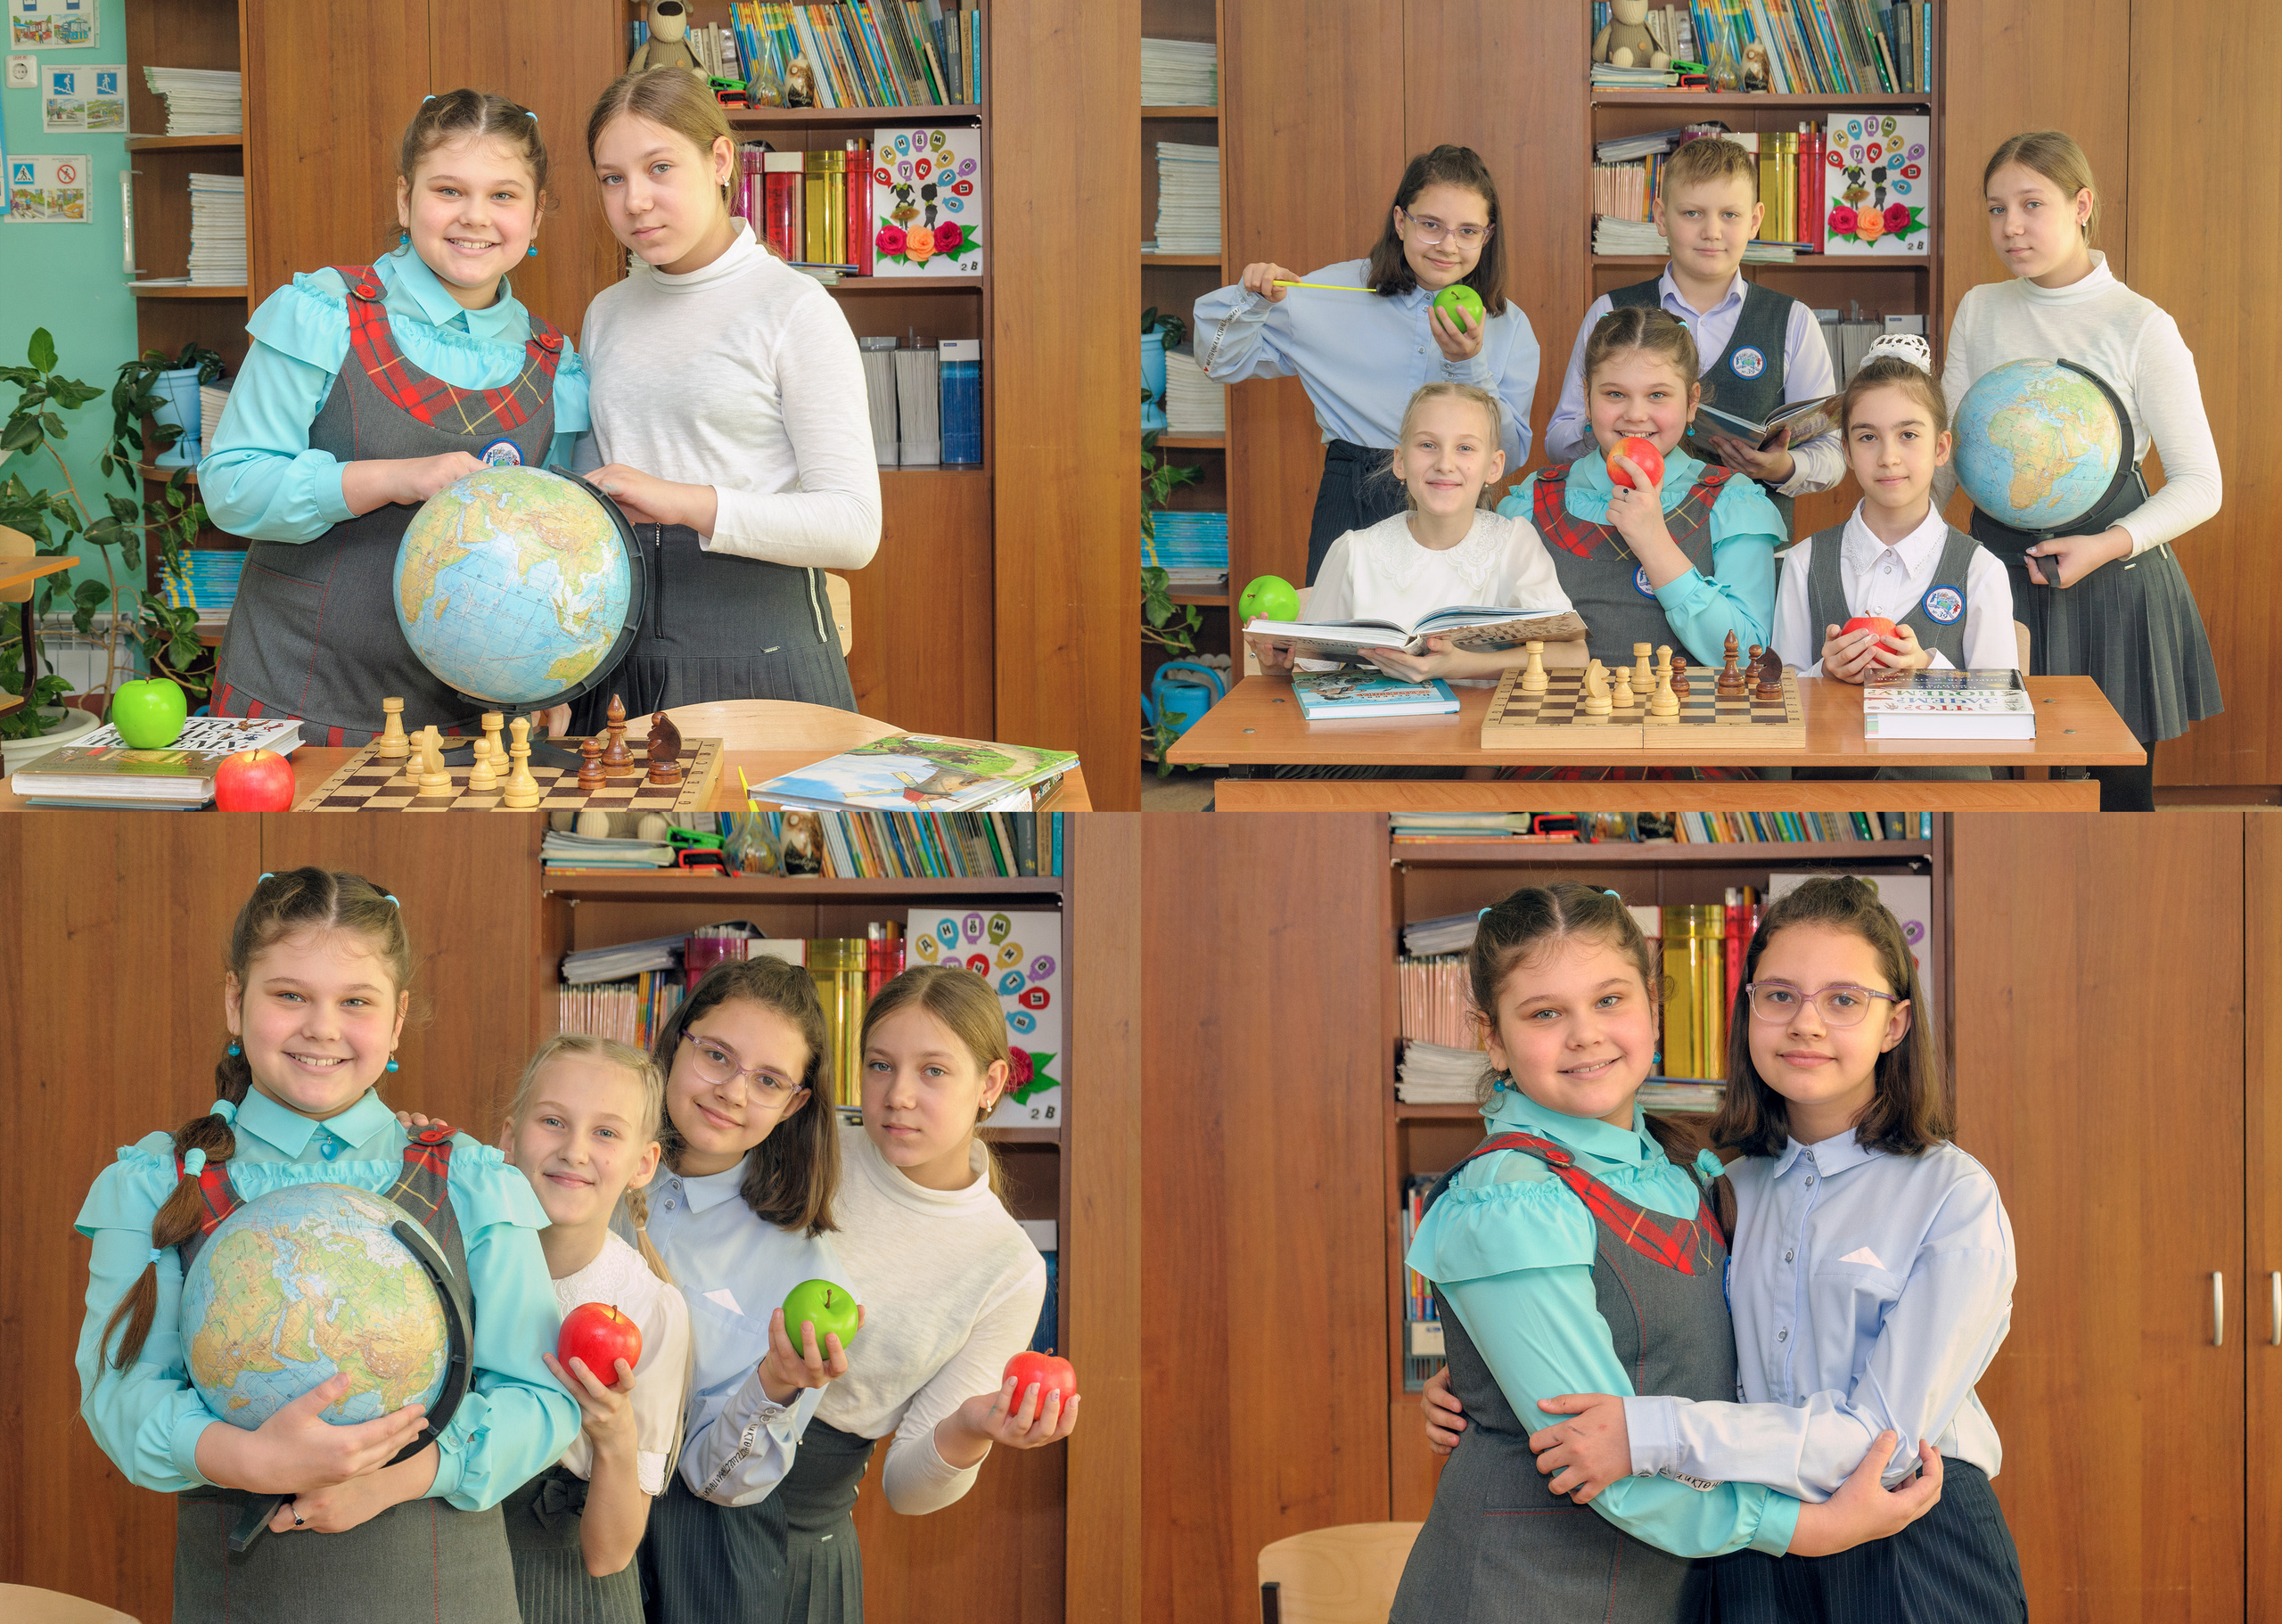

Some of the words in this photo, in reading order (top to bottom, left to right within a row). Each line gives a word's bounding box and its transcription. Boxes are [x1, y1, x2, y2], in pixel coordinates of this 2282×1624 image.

[1938, 611, 1948, 619] 39
[1031, 1109, 1039, 1119] 2
[1045, 1106, 1055, 1119] В
[1691, 1478, 1712, 1489] КТО
